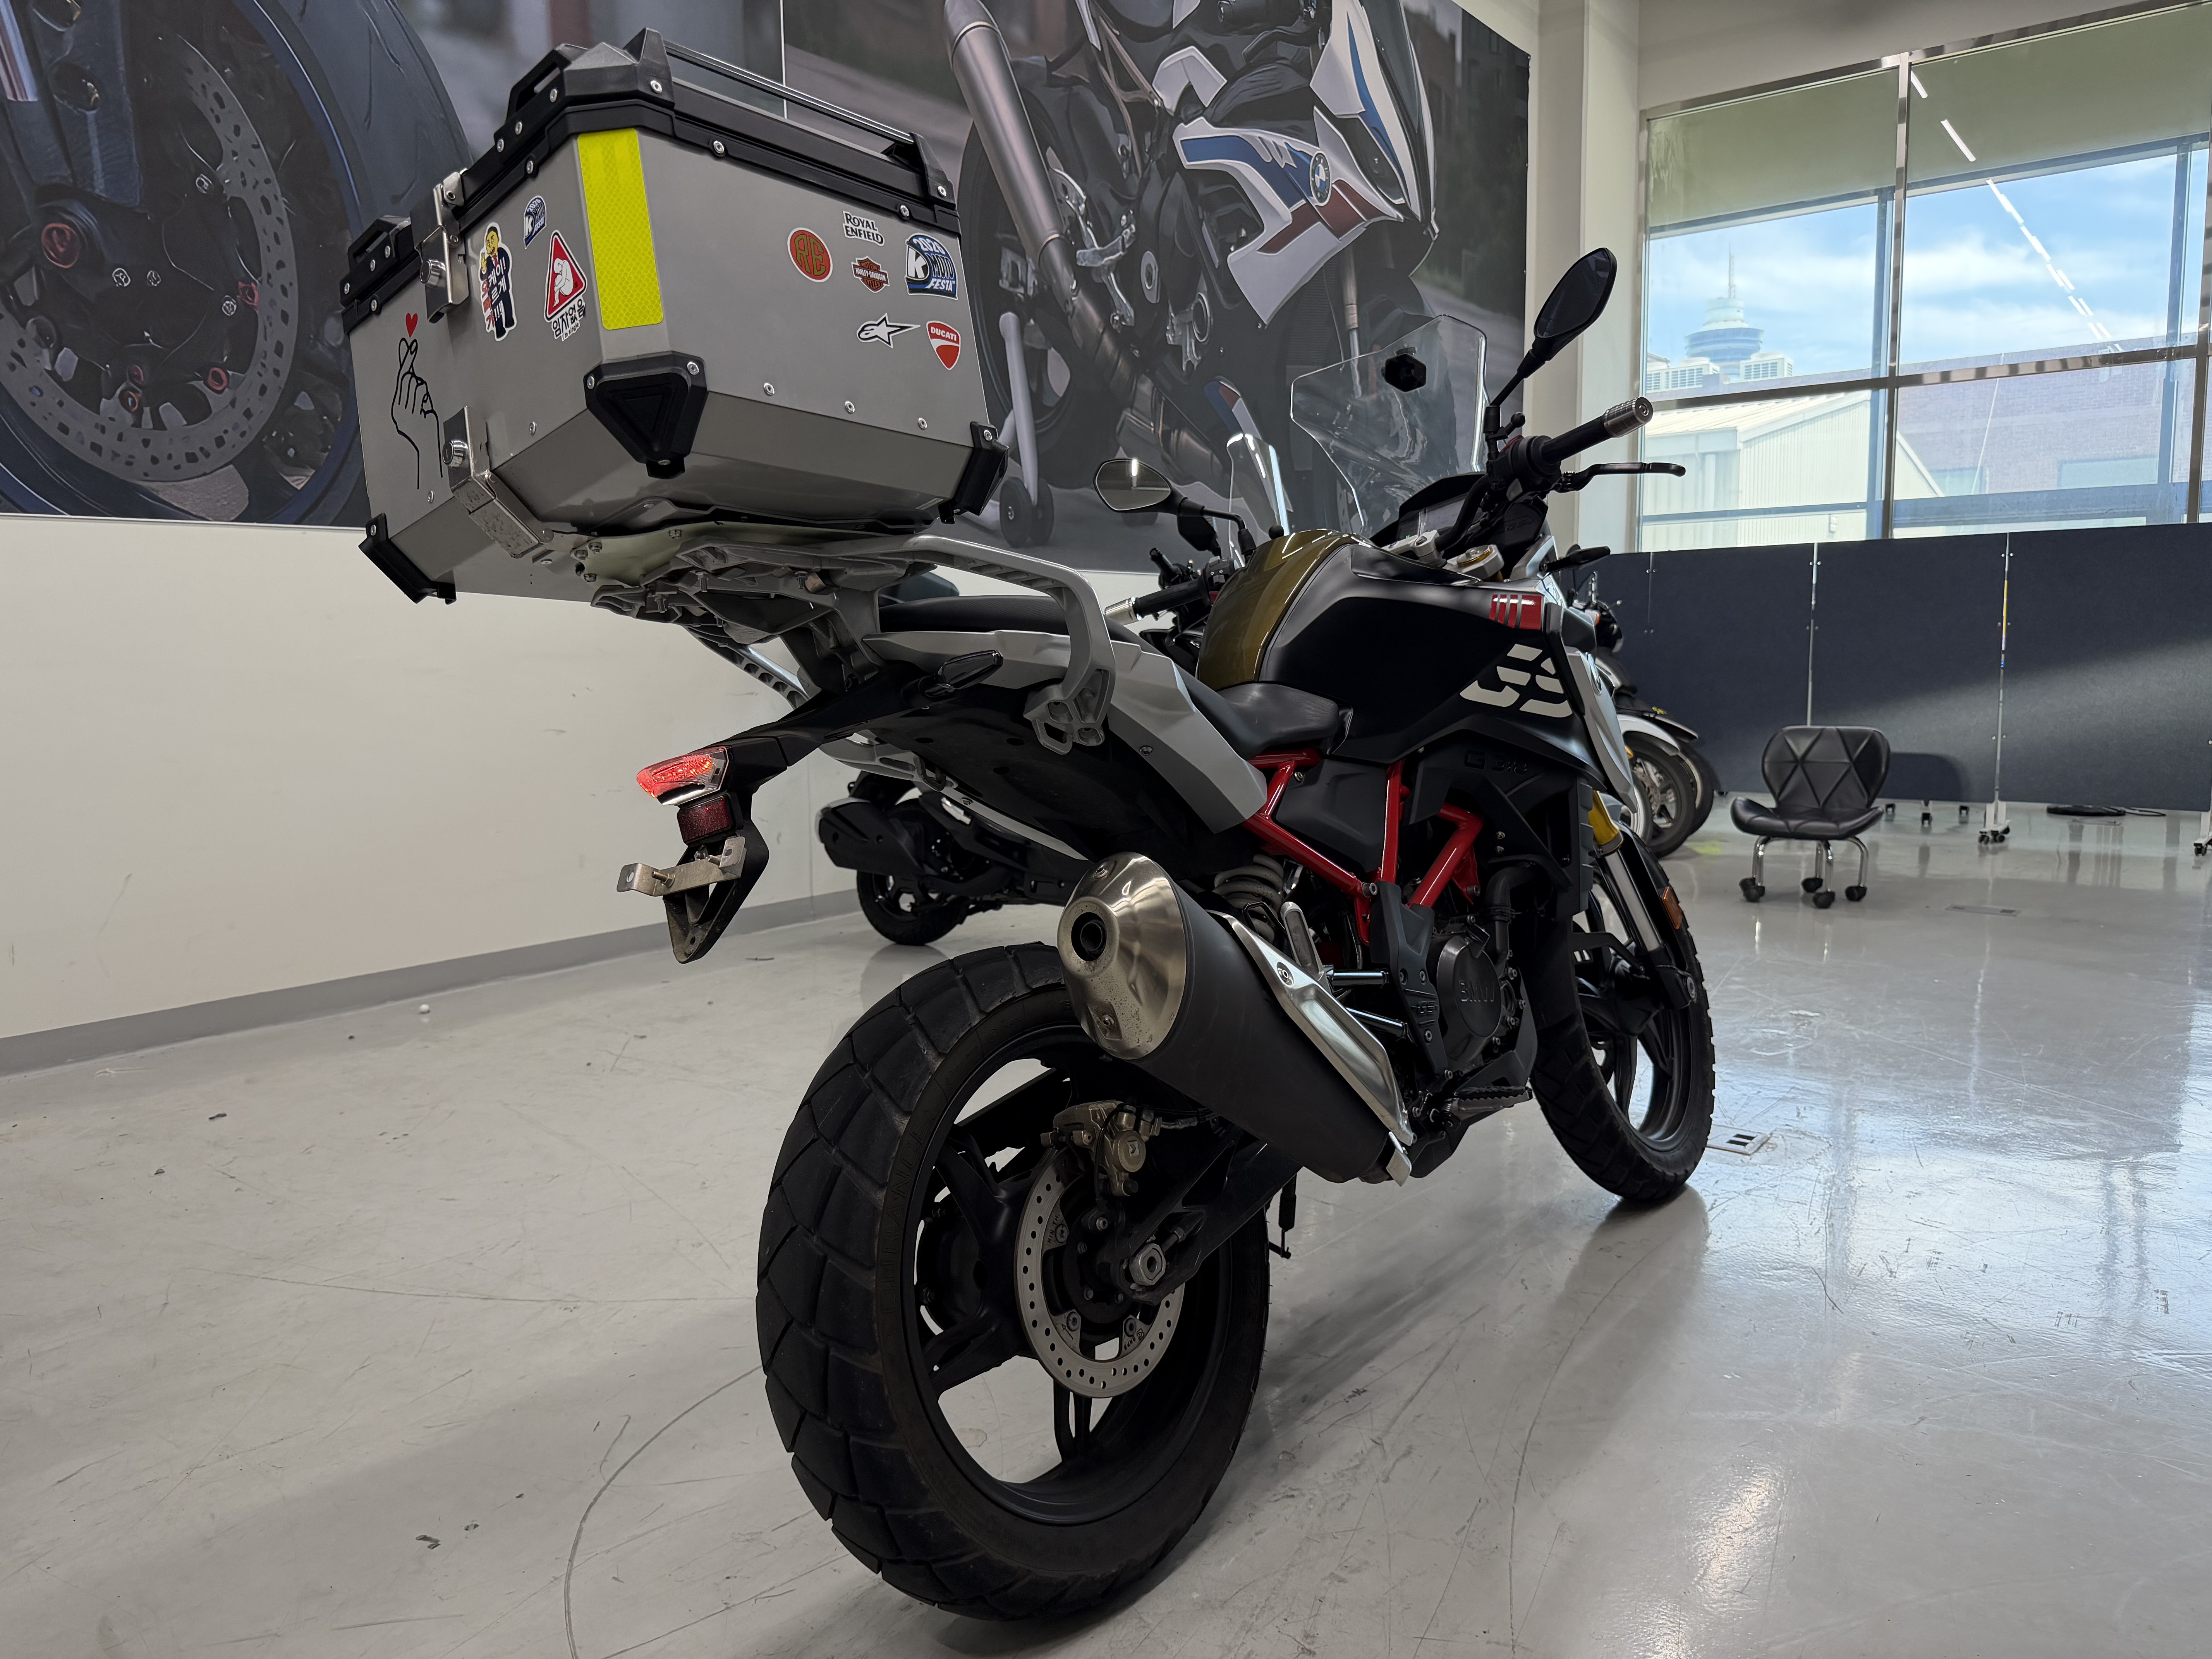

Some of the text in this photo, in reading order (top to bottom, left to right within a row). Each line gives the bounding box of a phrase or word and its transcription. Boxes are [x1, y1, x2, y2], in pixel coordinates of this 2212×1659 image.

[525, 217, 533, 237] K
[845, 213, 878, 231] ROYAL
[844, 225, 884, 245] ENFIELD
[794, 234, 827, 276] RE
[912, 237, 946, 255] 2026
[907, 247, 927, 279] K
[924, 252, 954, 279] MOTO
[930, 326, 957, 342] DUCATI
[1458, 980, 1494, 1002] BMW
